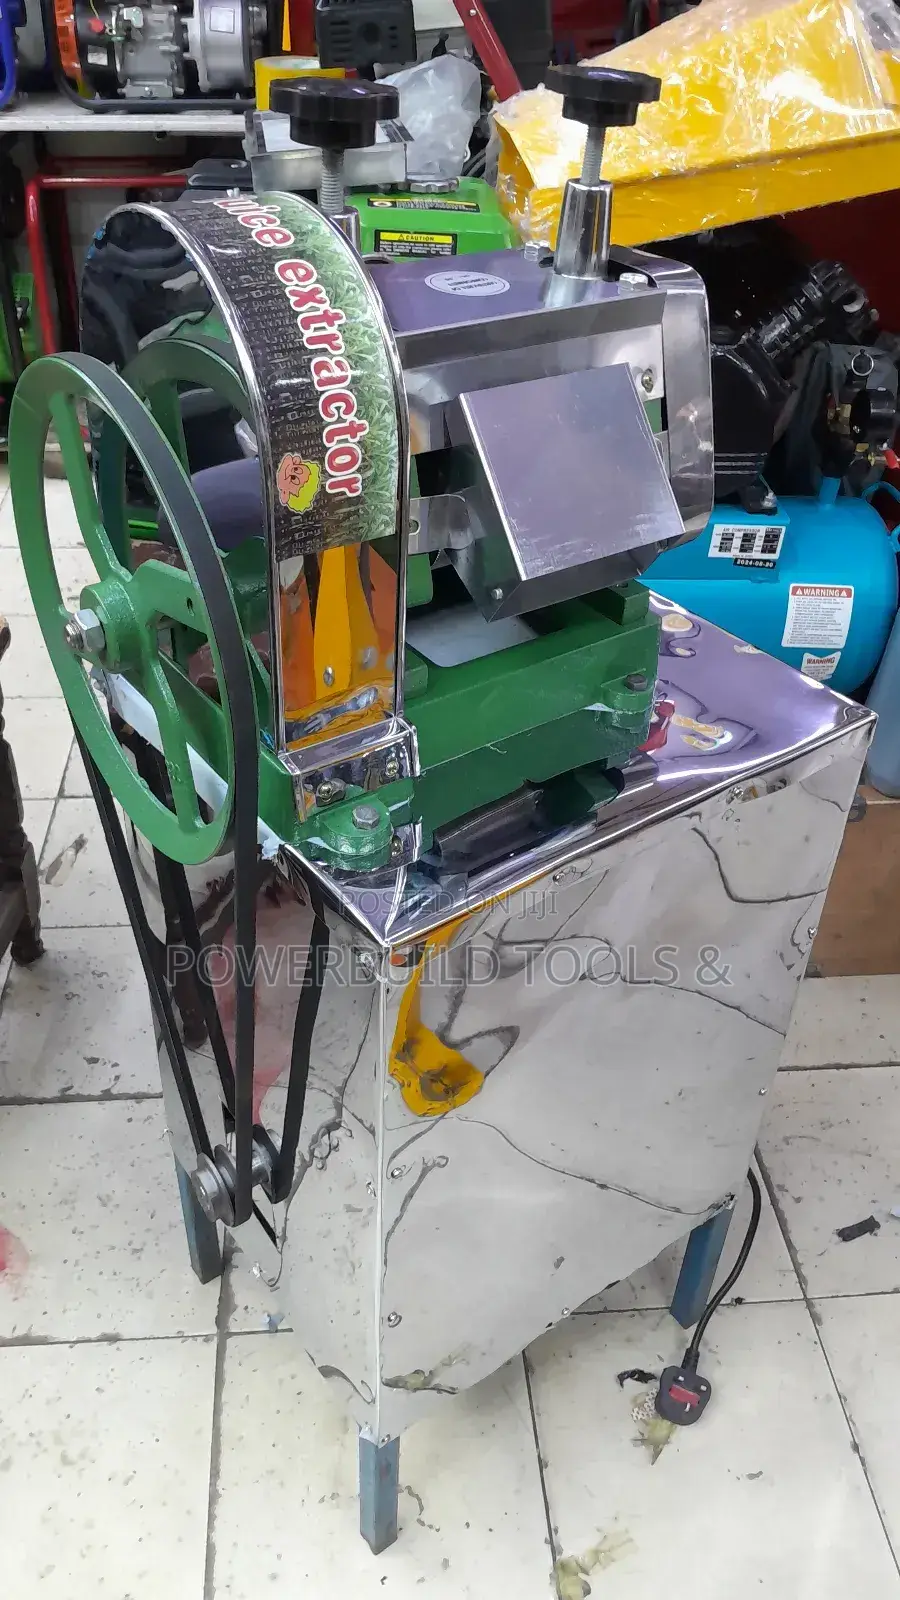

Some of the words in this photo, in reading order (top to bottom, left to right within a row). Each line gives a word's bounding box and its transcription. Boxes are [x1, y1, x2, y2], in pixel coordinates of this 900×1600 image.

[213, 196, 295, 247] uice
[274, 259, 369, 497] extractor
[803, 588, 840, 597] WARNING
[806, 656, 836, 665] WARNING
